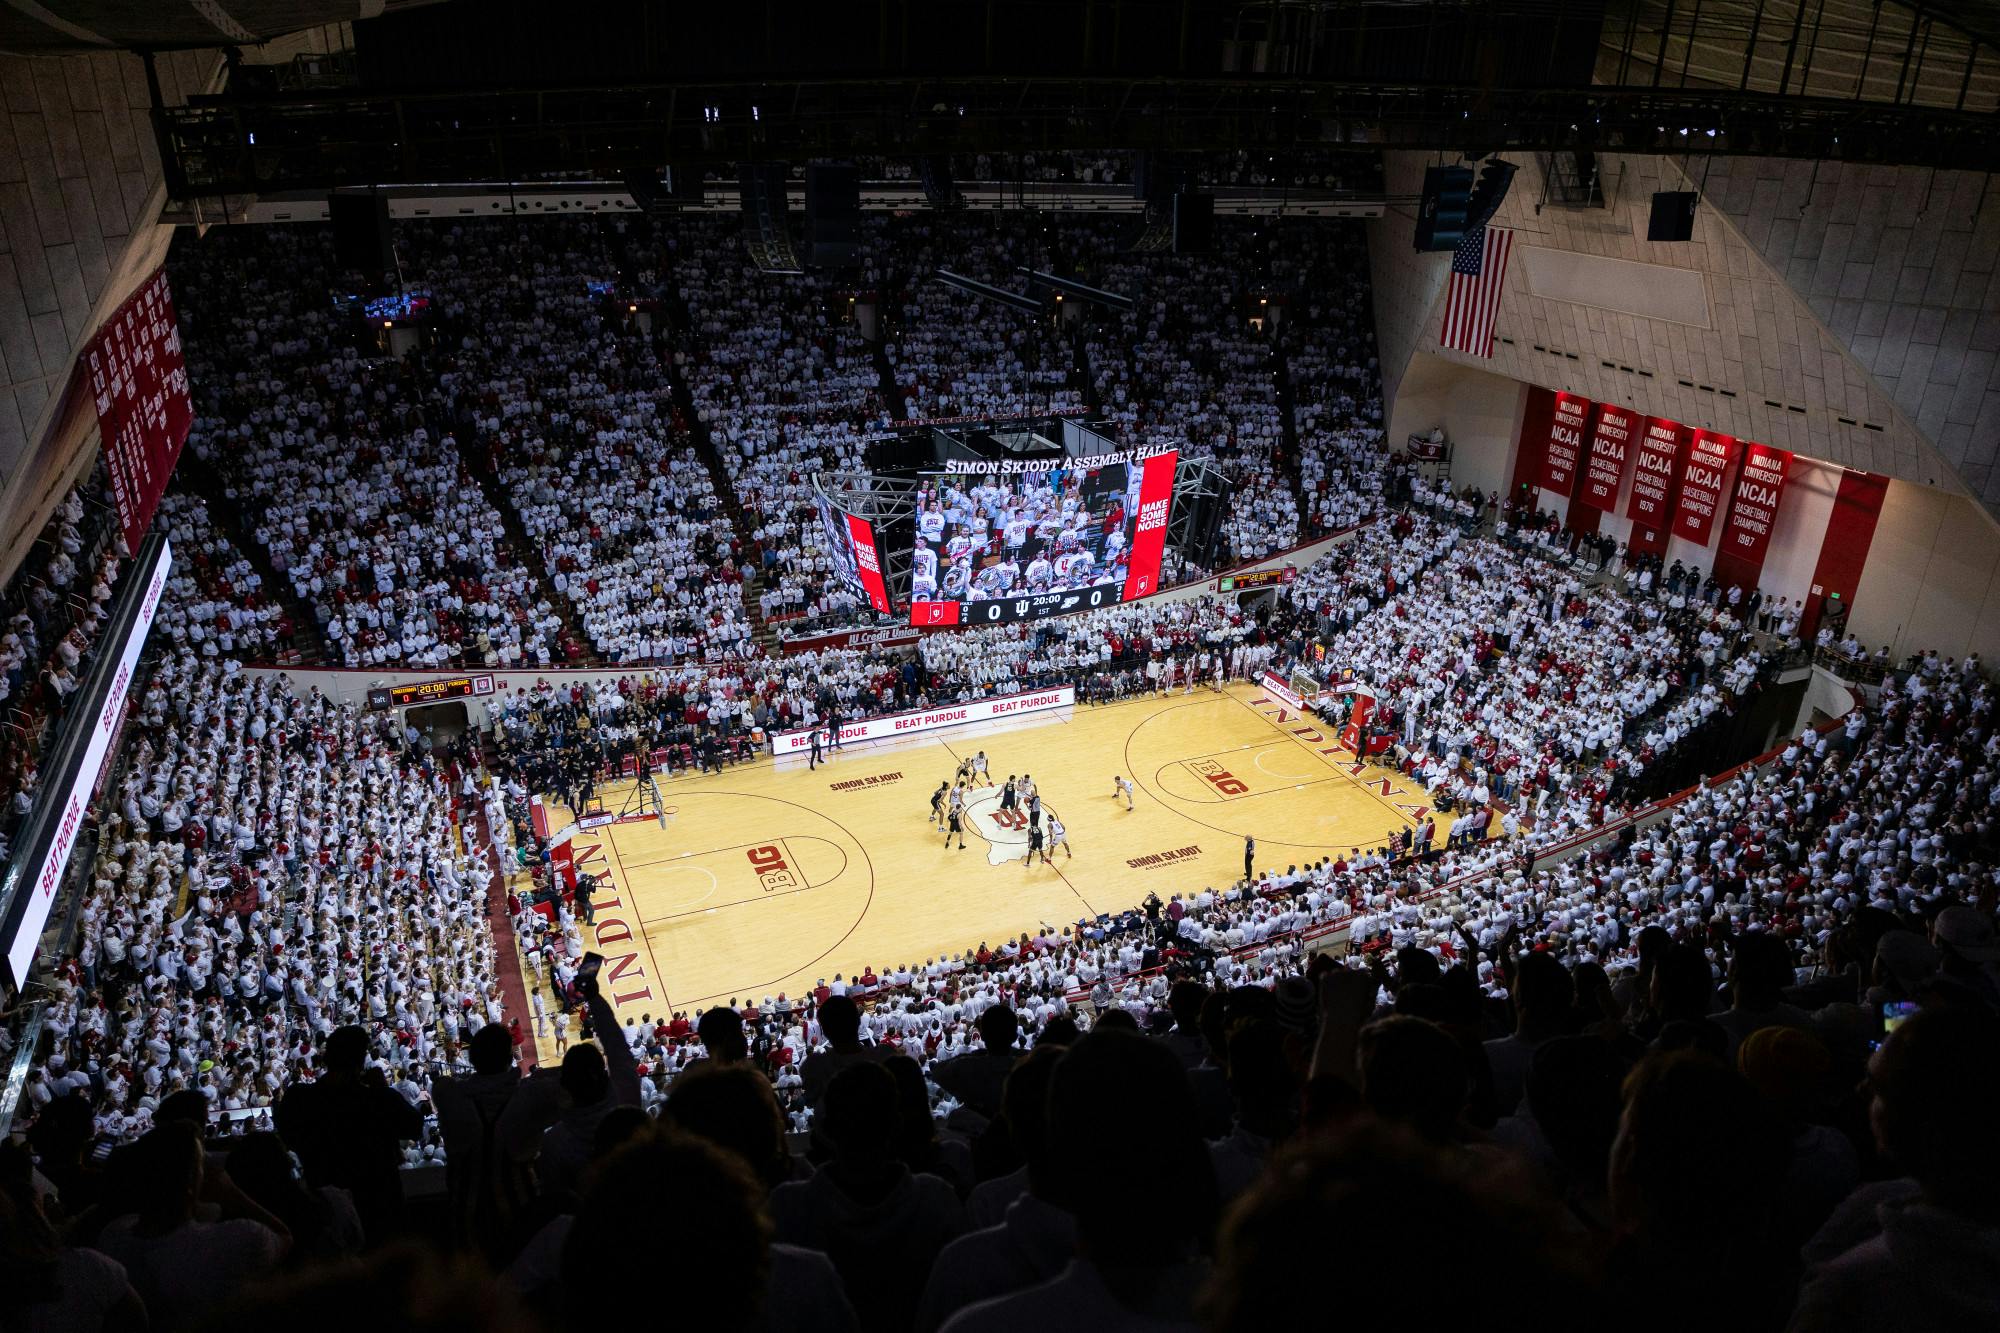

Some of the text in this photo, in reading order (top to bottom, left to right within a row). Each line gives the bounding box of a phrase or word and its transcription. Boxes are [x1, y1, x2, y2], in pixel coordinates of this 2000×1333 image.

[1560, 401, 1582, 415] INDIANA
[1555, 411, 1583, 428] UNIVERSITY
[1603, 413, 1627, 428] INDIANA
[1551, 425, 1580, 447] NCAA
[1597, 423, 1629, 440] UNIVERSITY
[1649, 425, 1675, 441] INDIANA
[1592, 437, 1624, 461] NCAA
[1644, 436, 1677, 455] UNIVERSITY
[1698, 439, 1726, 456] INDIANA
[945, 459, 998, 474] SIMON
[1062, 450, 1135, 471] ASSEMBLY
[1135, 444, 1169, 460] HALL
[1590, 456, 1620, 474] BASKETBALL
[1638, 451, 1672, 476] NCAA
[1691, 450, 1728, 469] UNIVERSITY
[1751, 454, 1782, 472] INDIANA
[1551, 470, 1564, 482] 1940
[1589, 468, 1617, 485] CHAMPIONS
[1636, 470, 1667, 489] BASKETBALL
[1685, 465, 1721, 491] NCAA
[1744, 465, 1783, 486] UNIVERSITY
[1592, 483, 1608, 497] 1953
[1635, 483, 1664, 501] CHAMPIONS
[1682, 485, 1715, 505] BASKETBALL
[1737, 481, 1777, 508] NCAA
[1141, 498, 1168, 513] MAKE
[1639, 499, 1654, 513] 1976
[1681, 498, 1713, 517] CHAMPIONS
[1735, 502, 1771, 524] BASKETBALL
[1140, 508, 1167, 522] SOME
[1686, 515, 1701, 529] 1981
[1137, 517, 1166, 532] NOISE
[1733, 514, 1768, 535] CHAMPIONS
[855, 540, 875, 555] MAKE
[1737, 533, 1755, 547] 1987
[857, 549, 878, 564] SOME
[858, 558, 880, 574] NOISE
[1033, 594, 1061, 606] 20:00
[1090, 591, 1102, 606] 0
[988, 604, 1001, 620] 0
[848, 627, 919, 645] IU Credit Union
[419, 683, 445, 694] 20:00
[464, 686, 470, 694] 0
[1267, 679, 1280, 691] BEAT
[103, 697, 115, 733] BEAT
[112, 661, 128, 708] PURDUE
[403, 694, 410, 703] 0
[992, 694, 1060, 714] BEAT PURDUE
[895, 709, 967, 730] BEAT PURDUE
[1247, 697, 1430, 821] INDIANA
[830, 771, 904, 791] SIMON SKJODT
[42, 794, 80, 899] BEAT PURDUE
[1126, 845, 1203, 868] SIMON SKJODT
[1145, 860, 1179, 871] ASSEMBLY
